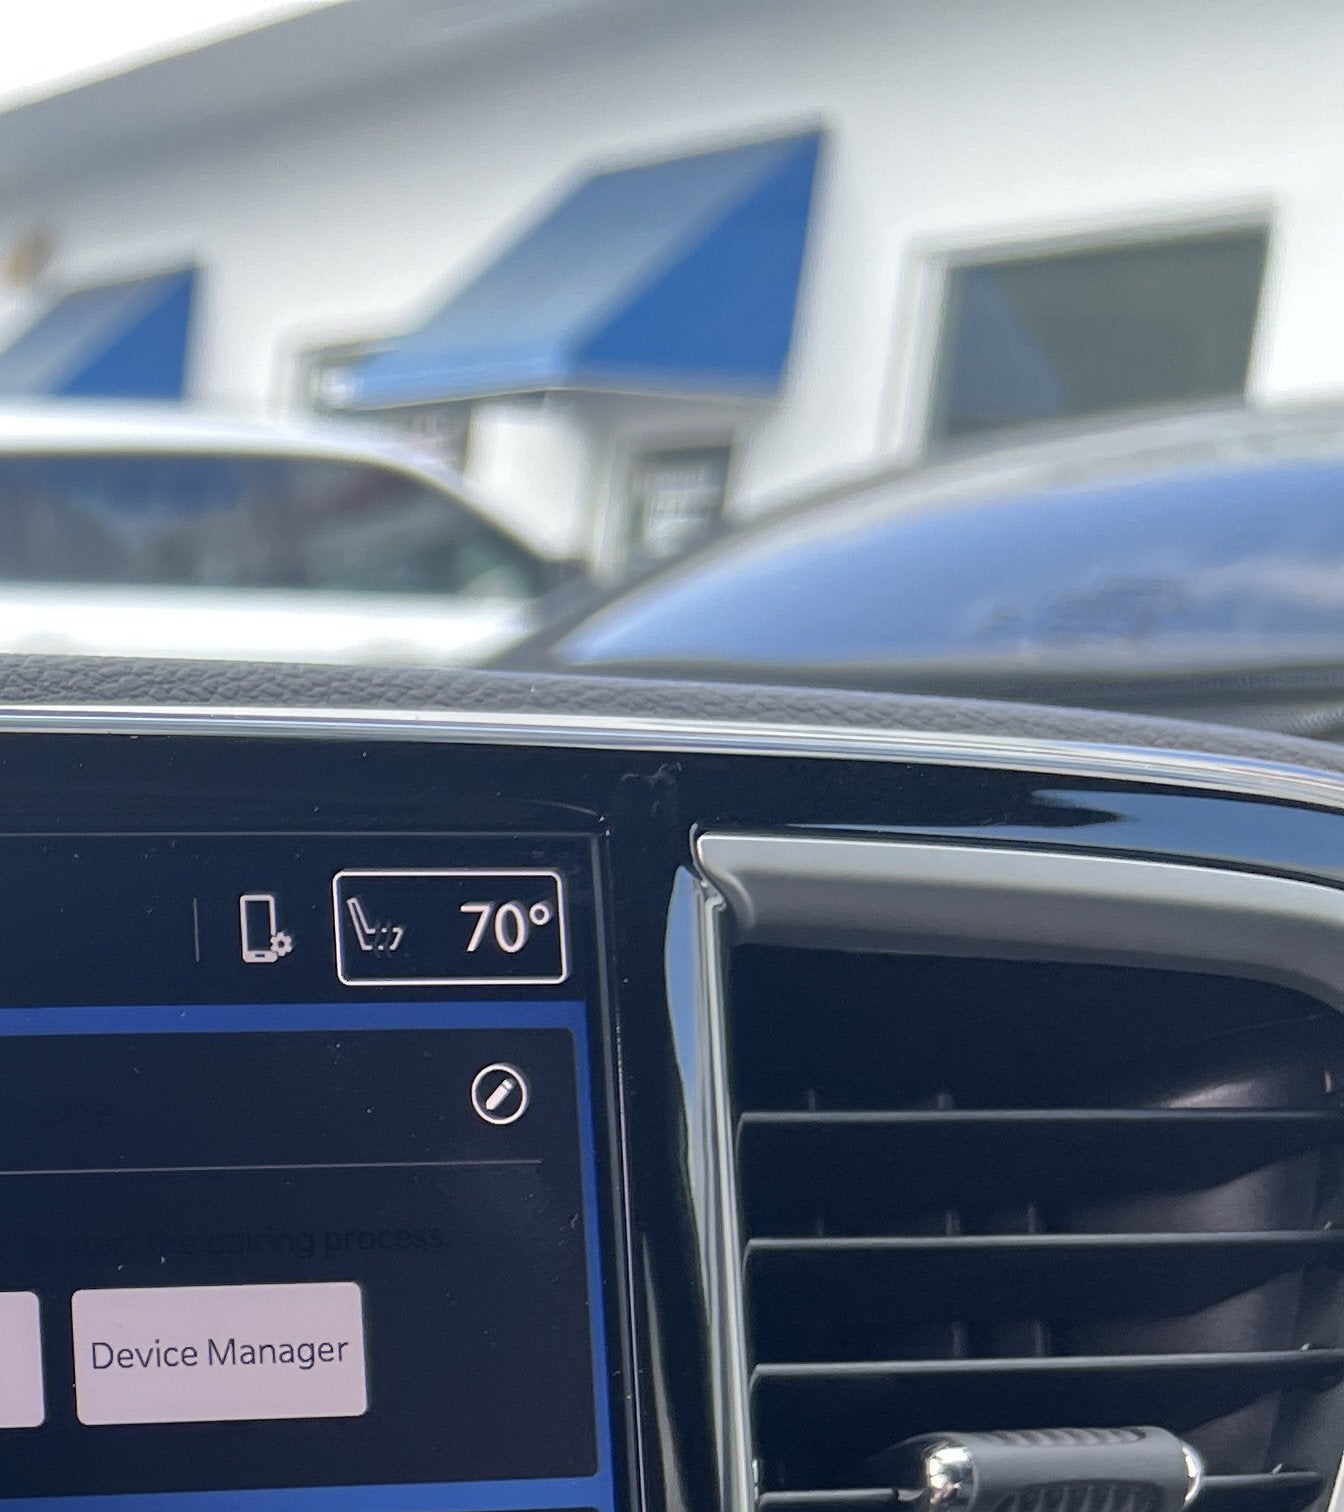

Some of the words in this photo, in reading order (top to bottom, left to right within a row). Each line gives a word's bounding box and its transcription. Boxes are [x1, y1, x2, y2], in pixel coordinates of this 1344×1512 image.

[460, 902, 551, 953] 70°
[91, 1342, 198, 1370] Device
[208, 1337, 349, 1370] Manager
